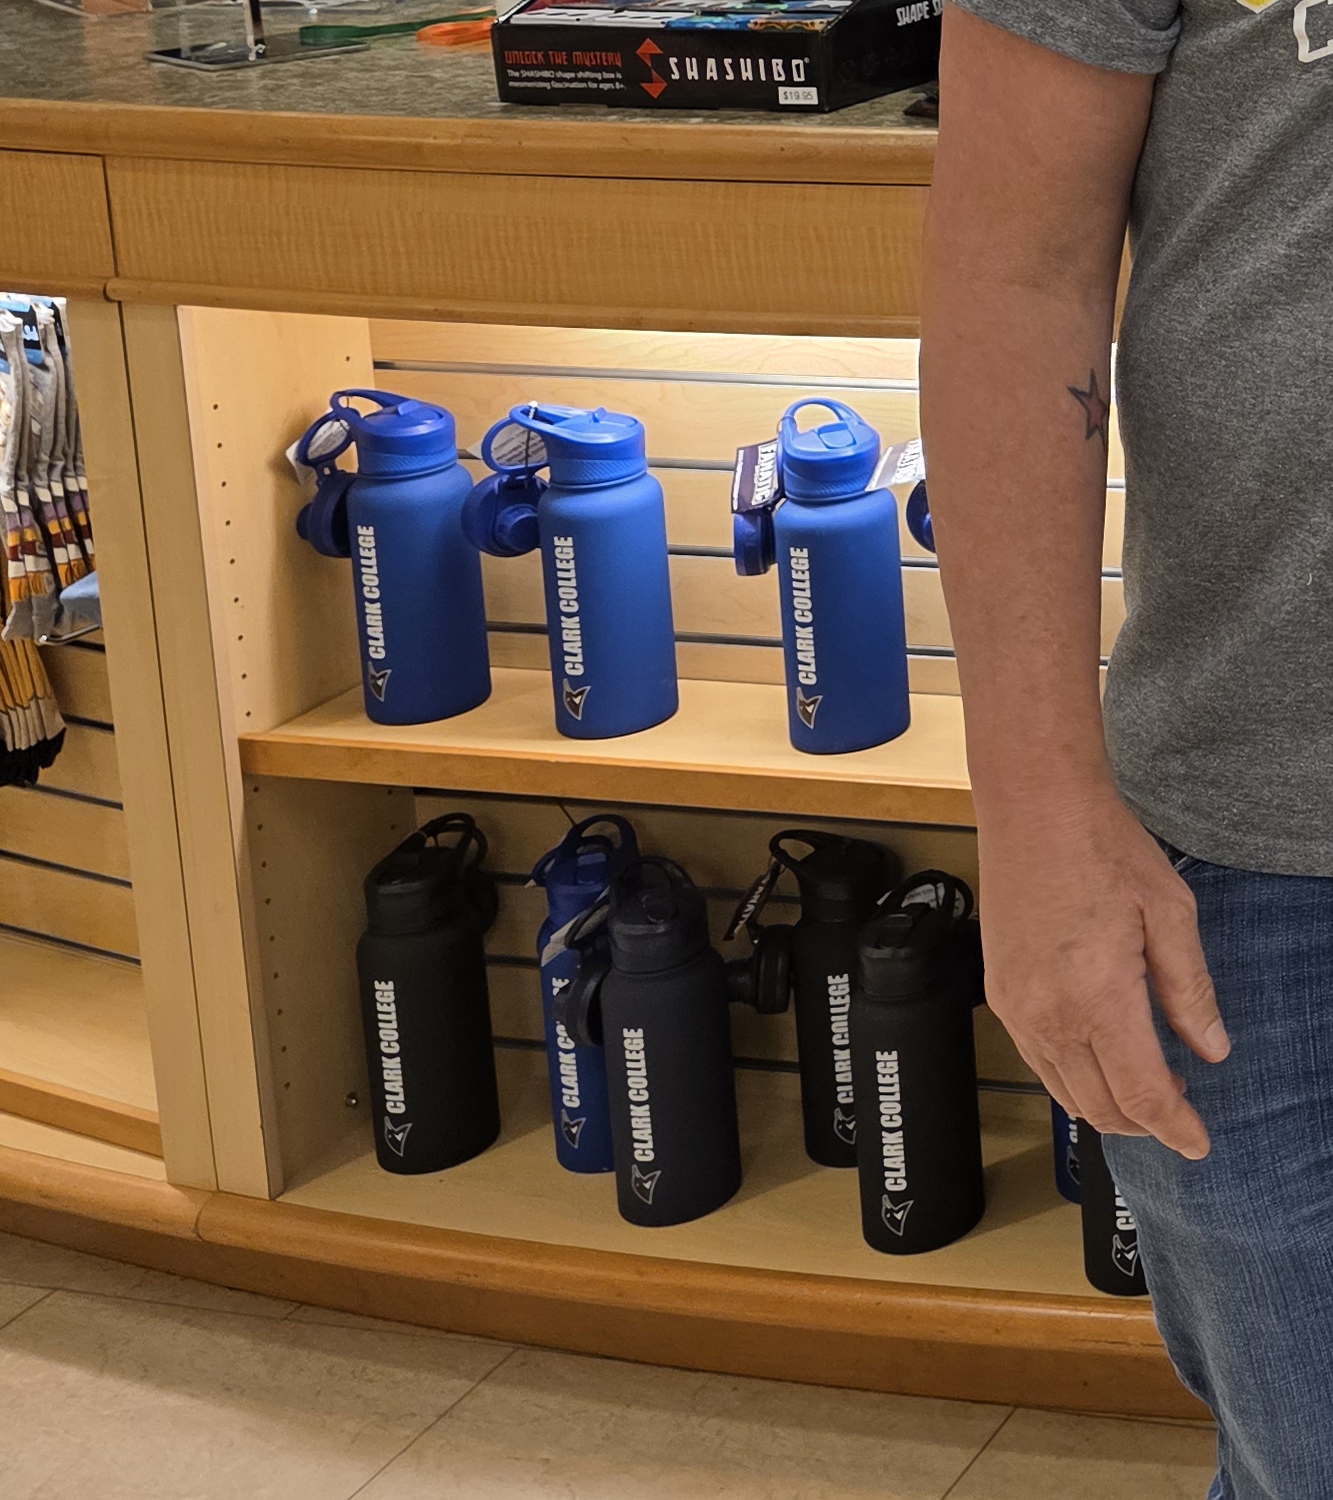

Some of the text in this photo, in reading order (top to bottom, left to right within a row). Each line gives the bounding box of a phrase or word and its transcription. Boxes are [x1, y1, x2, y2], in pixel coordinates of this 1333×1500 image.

[896, 1, 930, 26] SHAPE
[505, 50, 622, 69] UNLOCK THE MYSTERY
[507, 69, 520, 78] The
[556, 71, 576, 80] shape
[576, 71, 602, 80] shifting
[669, 57, 806, 82] SHASHIBO
[782, 90, 814, 101] $19.95
[755, 443, 778, 502] FANATIC
[357, 525, 386, 660] CLARK COLLEGE
[553, 536, 585, 676] CLARK COLLEGE
[789, 546, 817, 685] CLARK COLLEGE
[374, 980, 406, 1114] CLARK COLLEGE
[558, 1050, 582, 1109] CLARK
[622, 1027, 655, 1162] CLARK COLLEGE
[875, 1050, 908, 1193] CLARK COLLEGE
